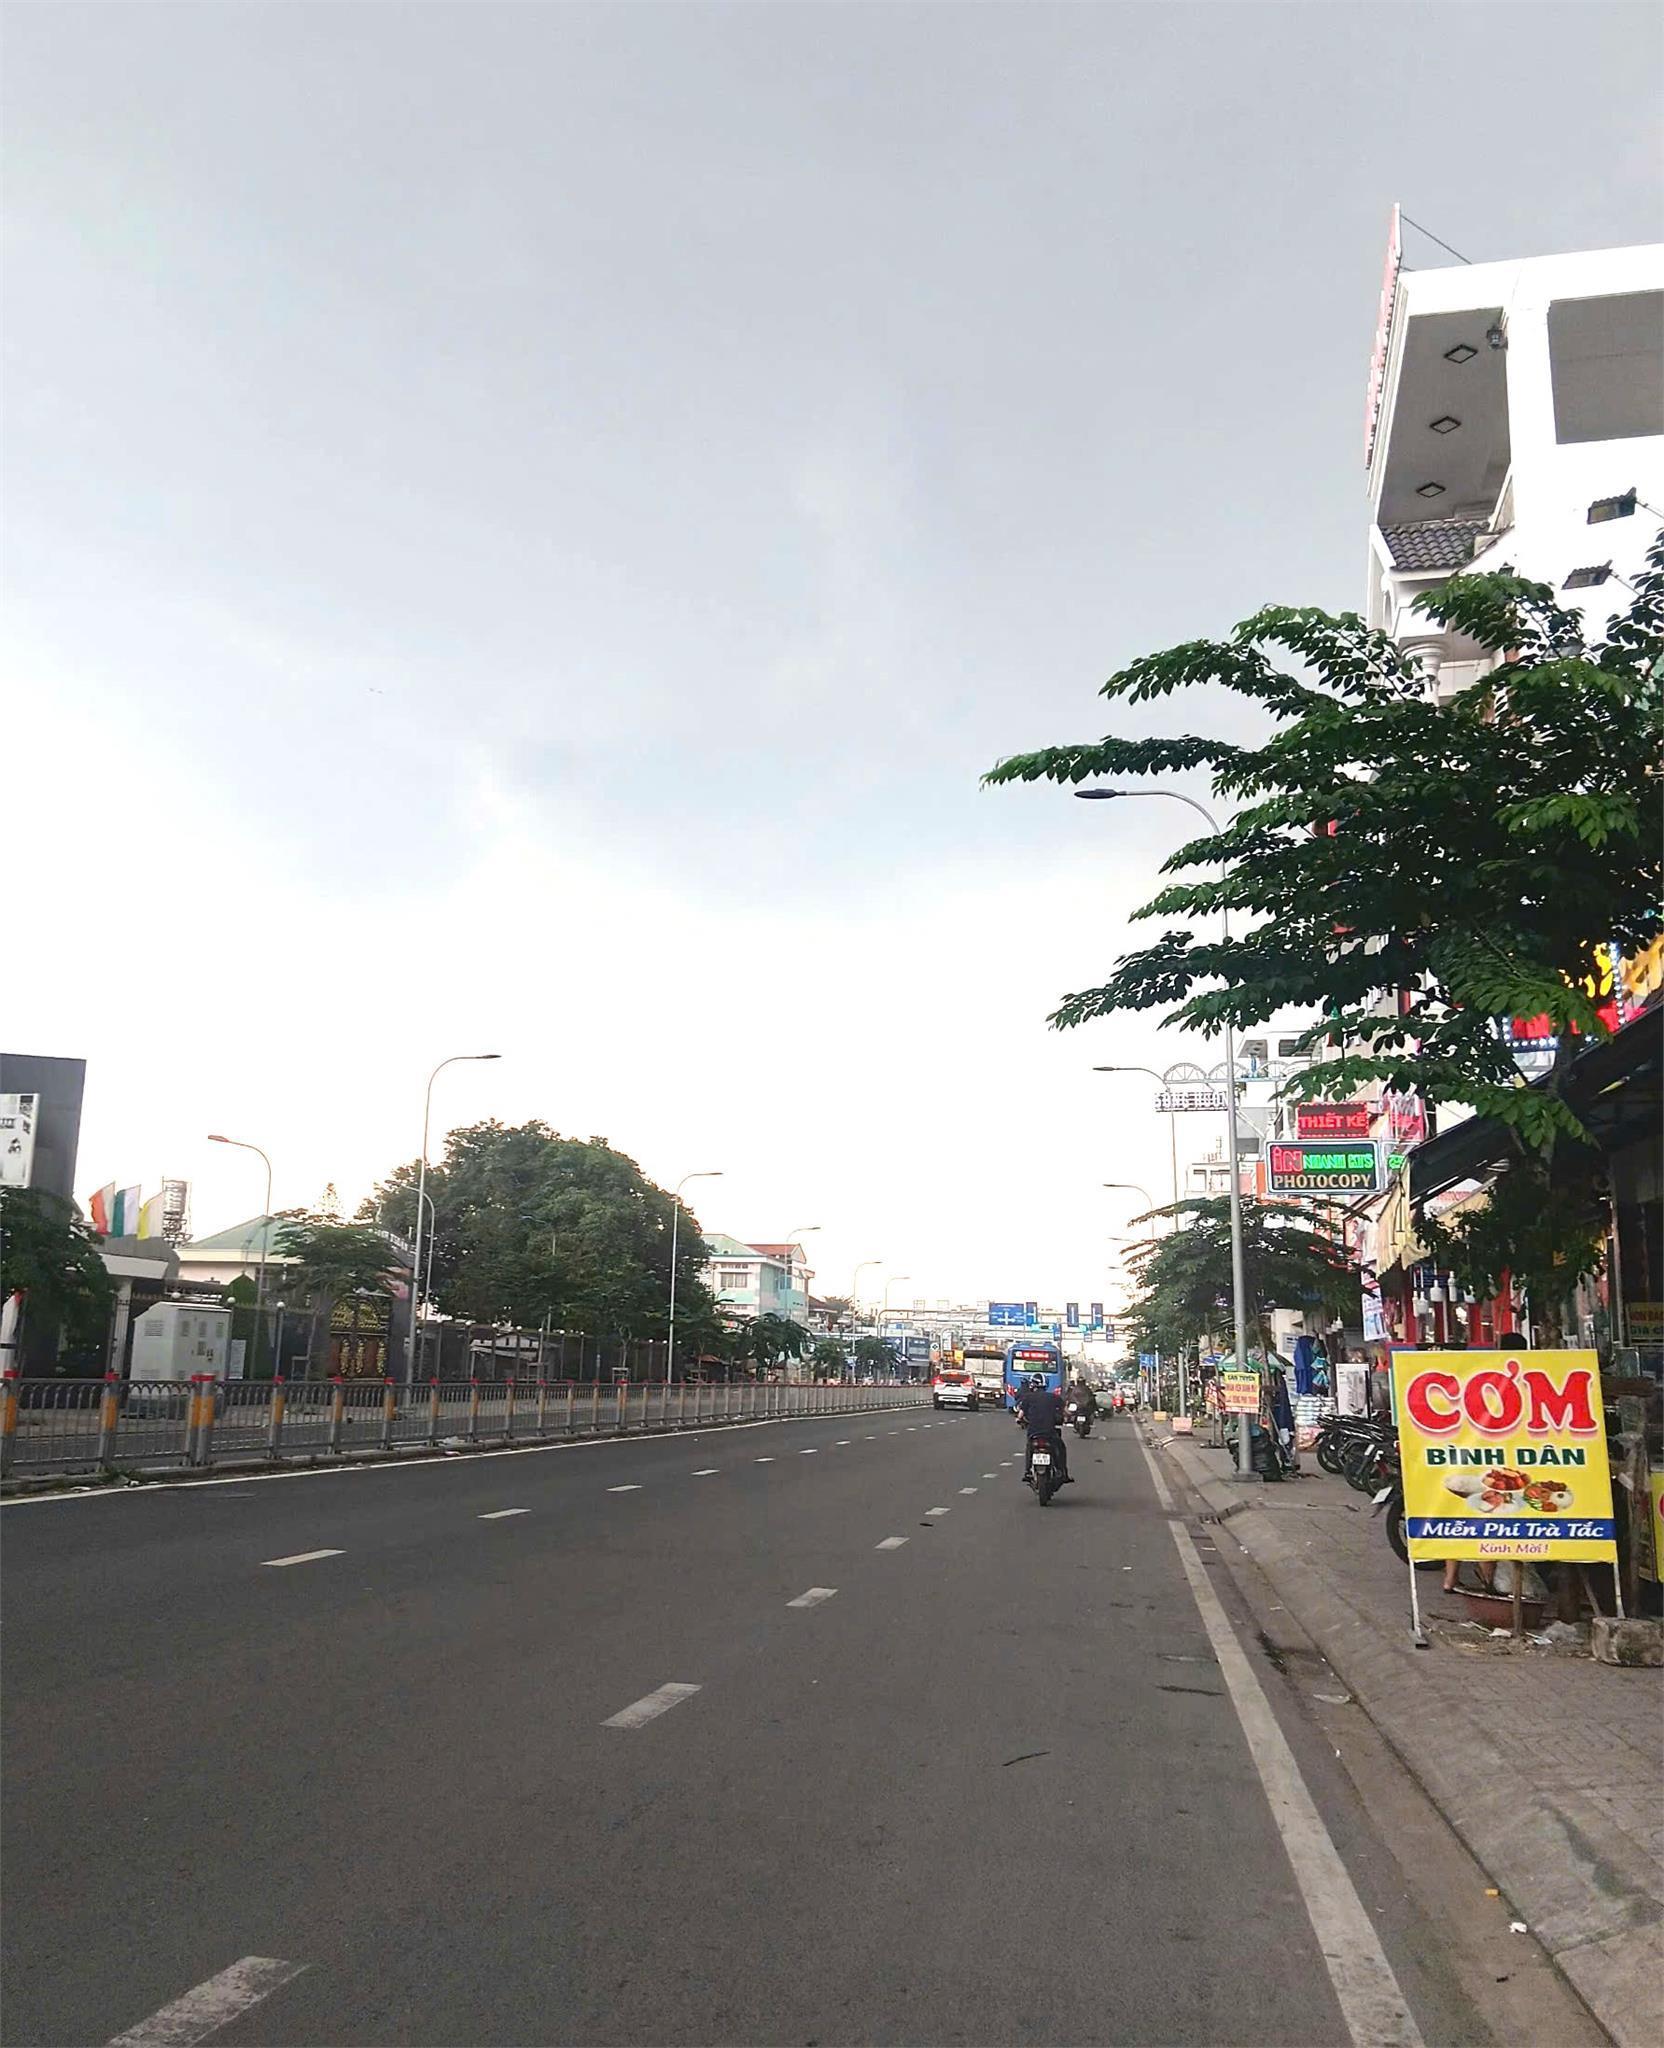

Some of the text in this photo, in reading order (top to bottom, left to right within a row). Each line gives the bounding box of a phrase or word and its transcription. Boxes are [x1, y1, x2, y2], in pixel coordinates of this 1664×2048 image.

[1273, 1174, 1372, 1189] PHOTOCOPY
[1406, 1360, 1598, 1431] CƠM
[1427, 1444, 1585, 1466] BÌNH DÂN
[1422, 1520, 1604, 1537] Miễn Phí Trà Tắc
